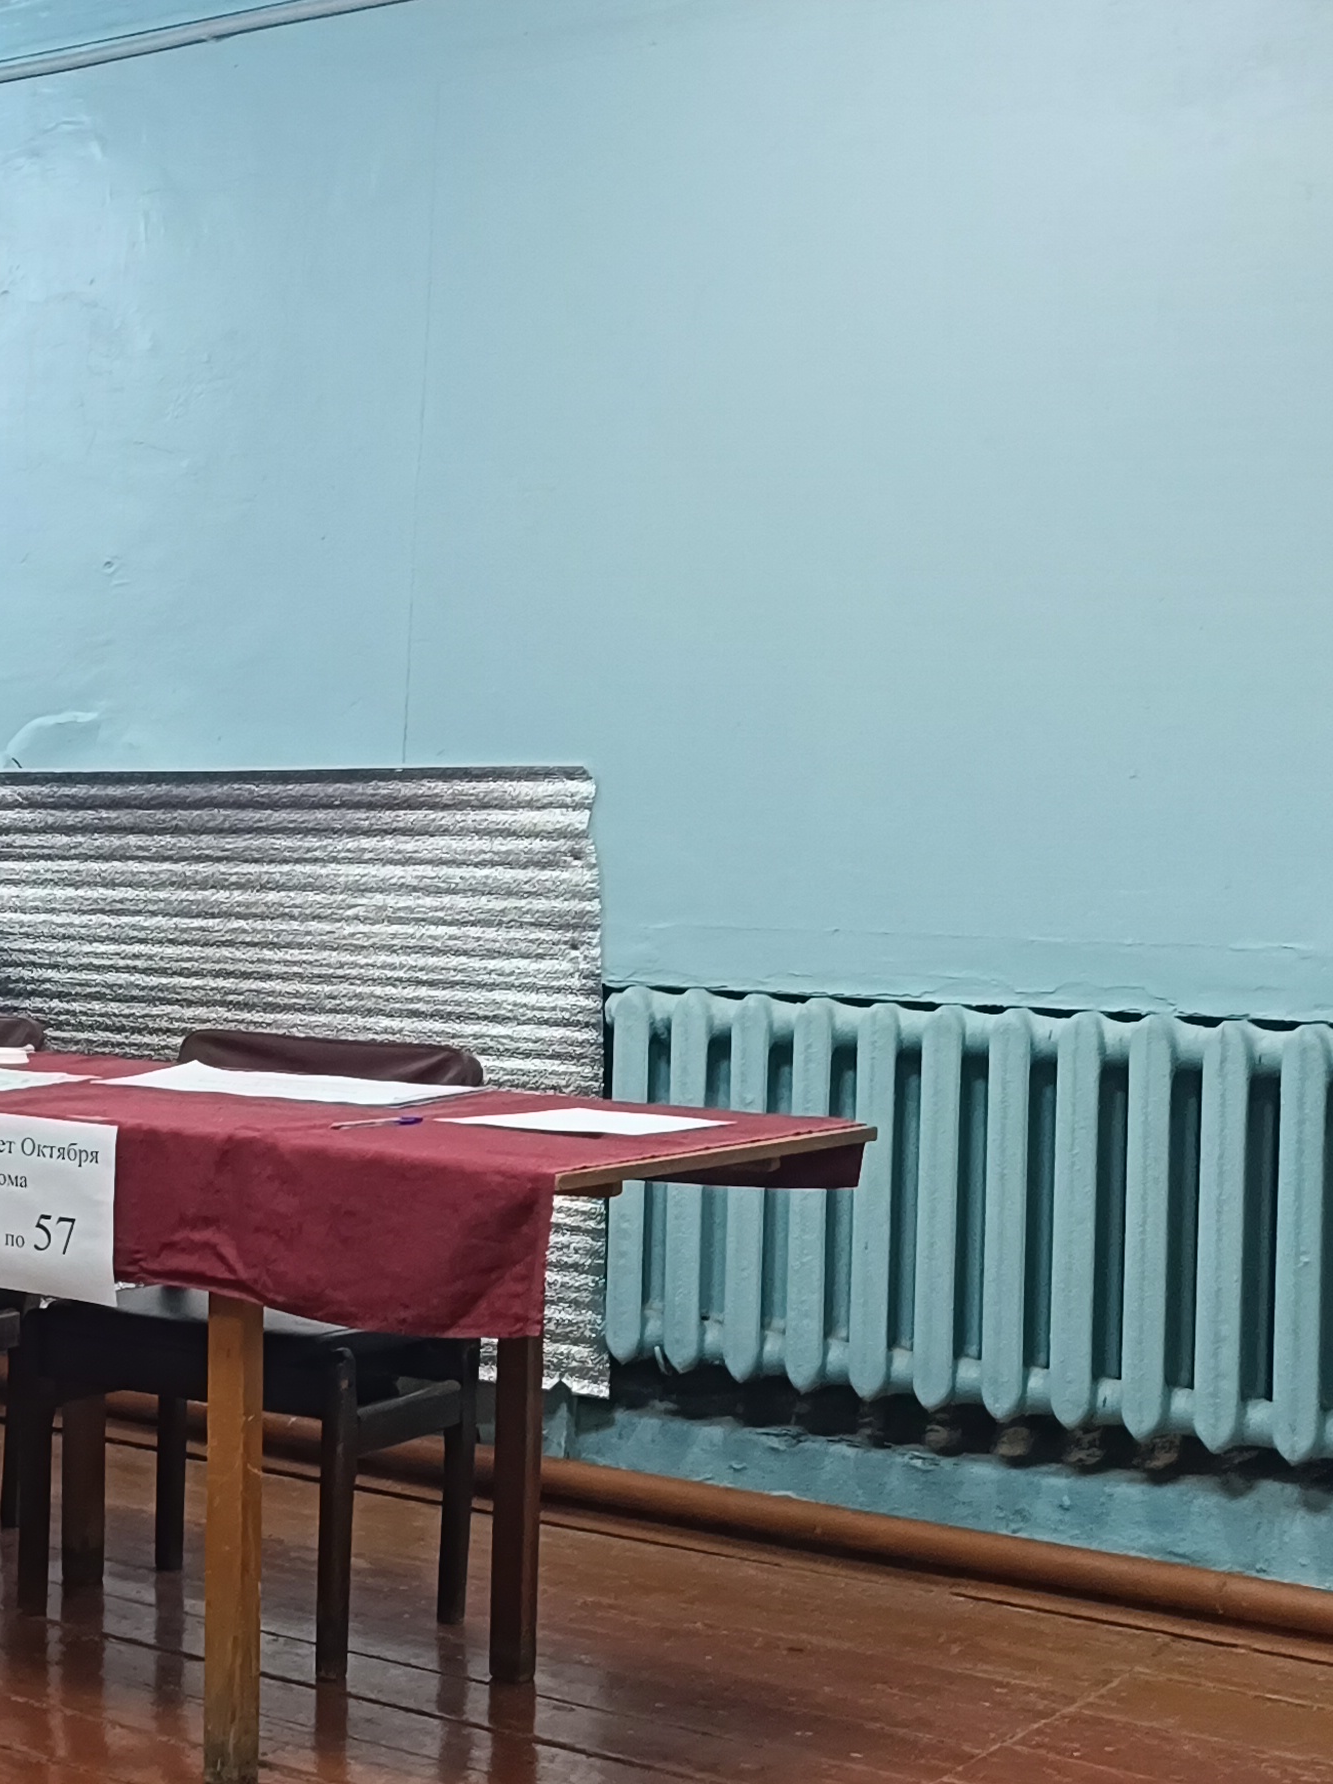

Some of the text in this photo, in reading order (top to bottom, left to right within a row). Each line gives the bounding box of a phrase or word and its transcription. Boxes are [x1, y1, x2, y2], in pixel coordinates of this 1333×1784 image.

[21, 1137, 99, 1167] Октября
[4, 1232, 25, 1248] по
[33, 1213, 76, 1255] 57
